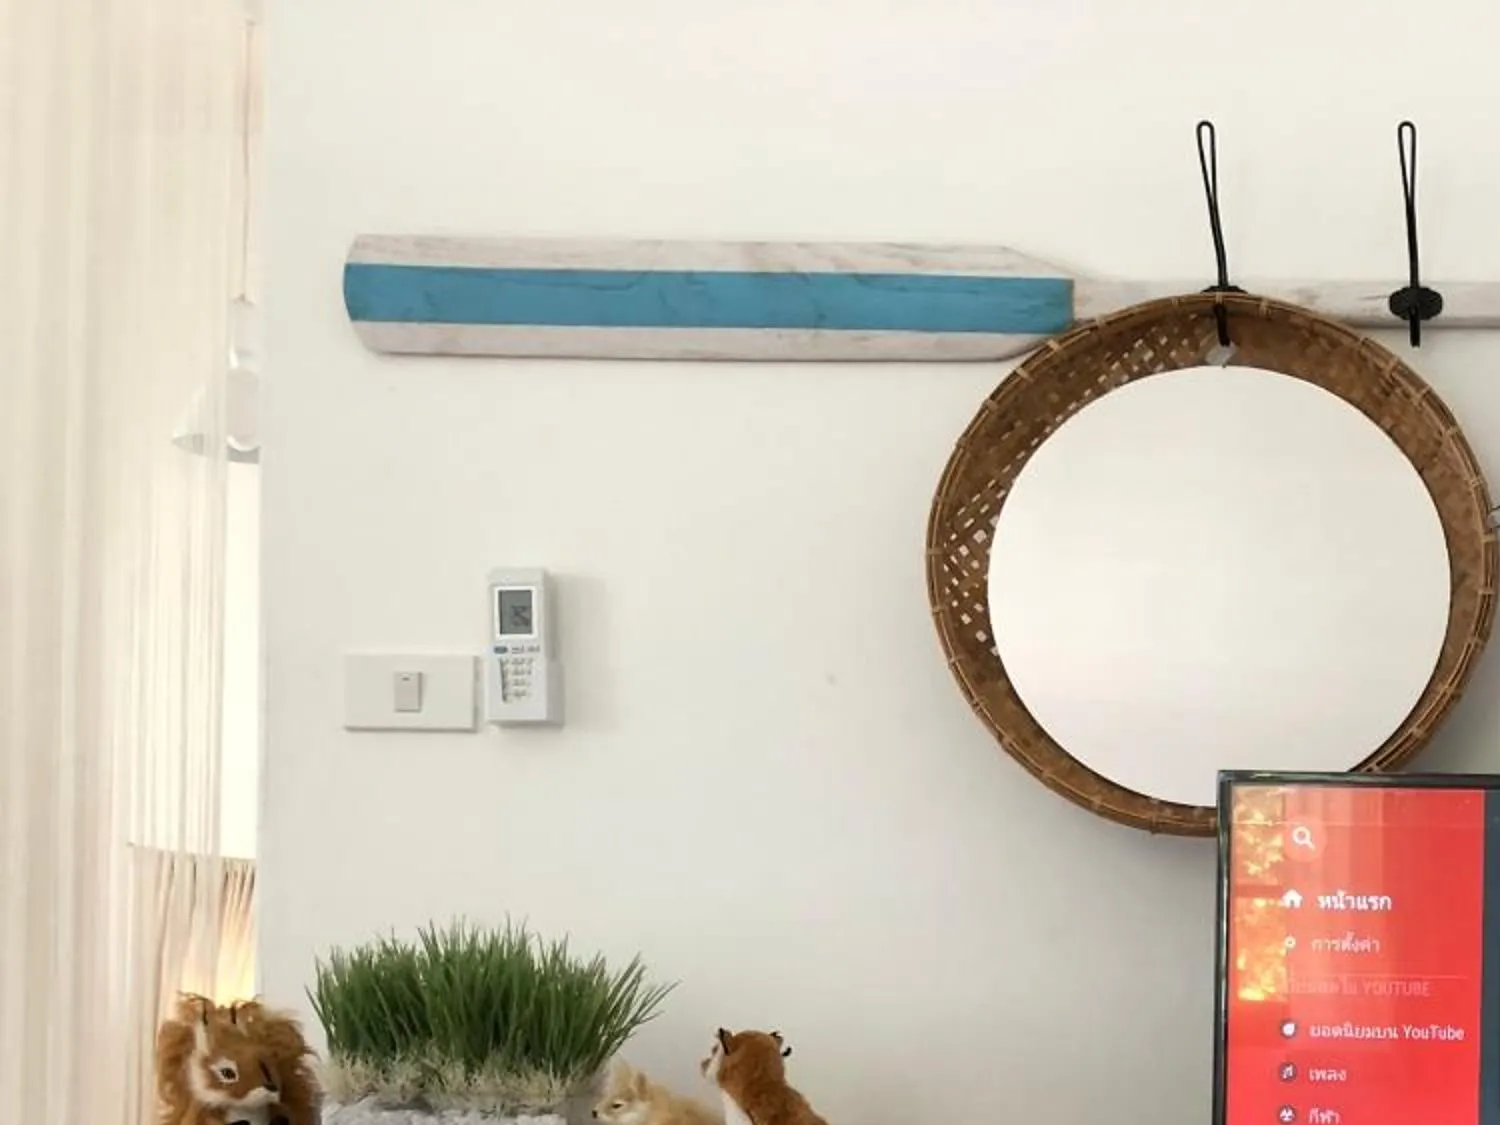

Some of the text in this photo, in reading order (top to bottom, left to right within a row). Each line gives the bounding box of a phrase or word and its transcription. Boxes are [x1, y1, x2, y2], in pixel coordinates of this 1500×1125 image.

[1316, 889, 1393, 911] หน้าแรก
[1311, 931, 1381, 953] การตั้งค่า
[1308, 1022, 1465, 1042] ยอดนิยมบน YouTube
[1309, 1067, 1347, 1082] เพลง
[1308, 1106, 1341, 1125] กีฬา
